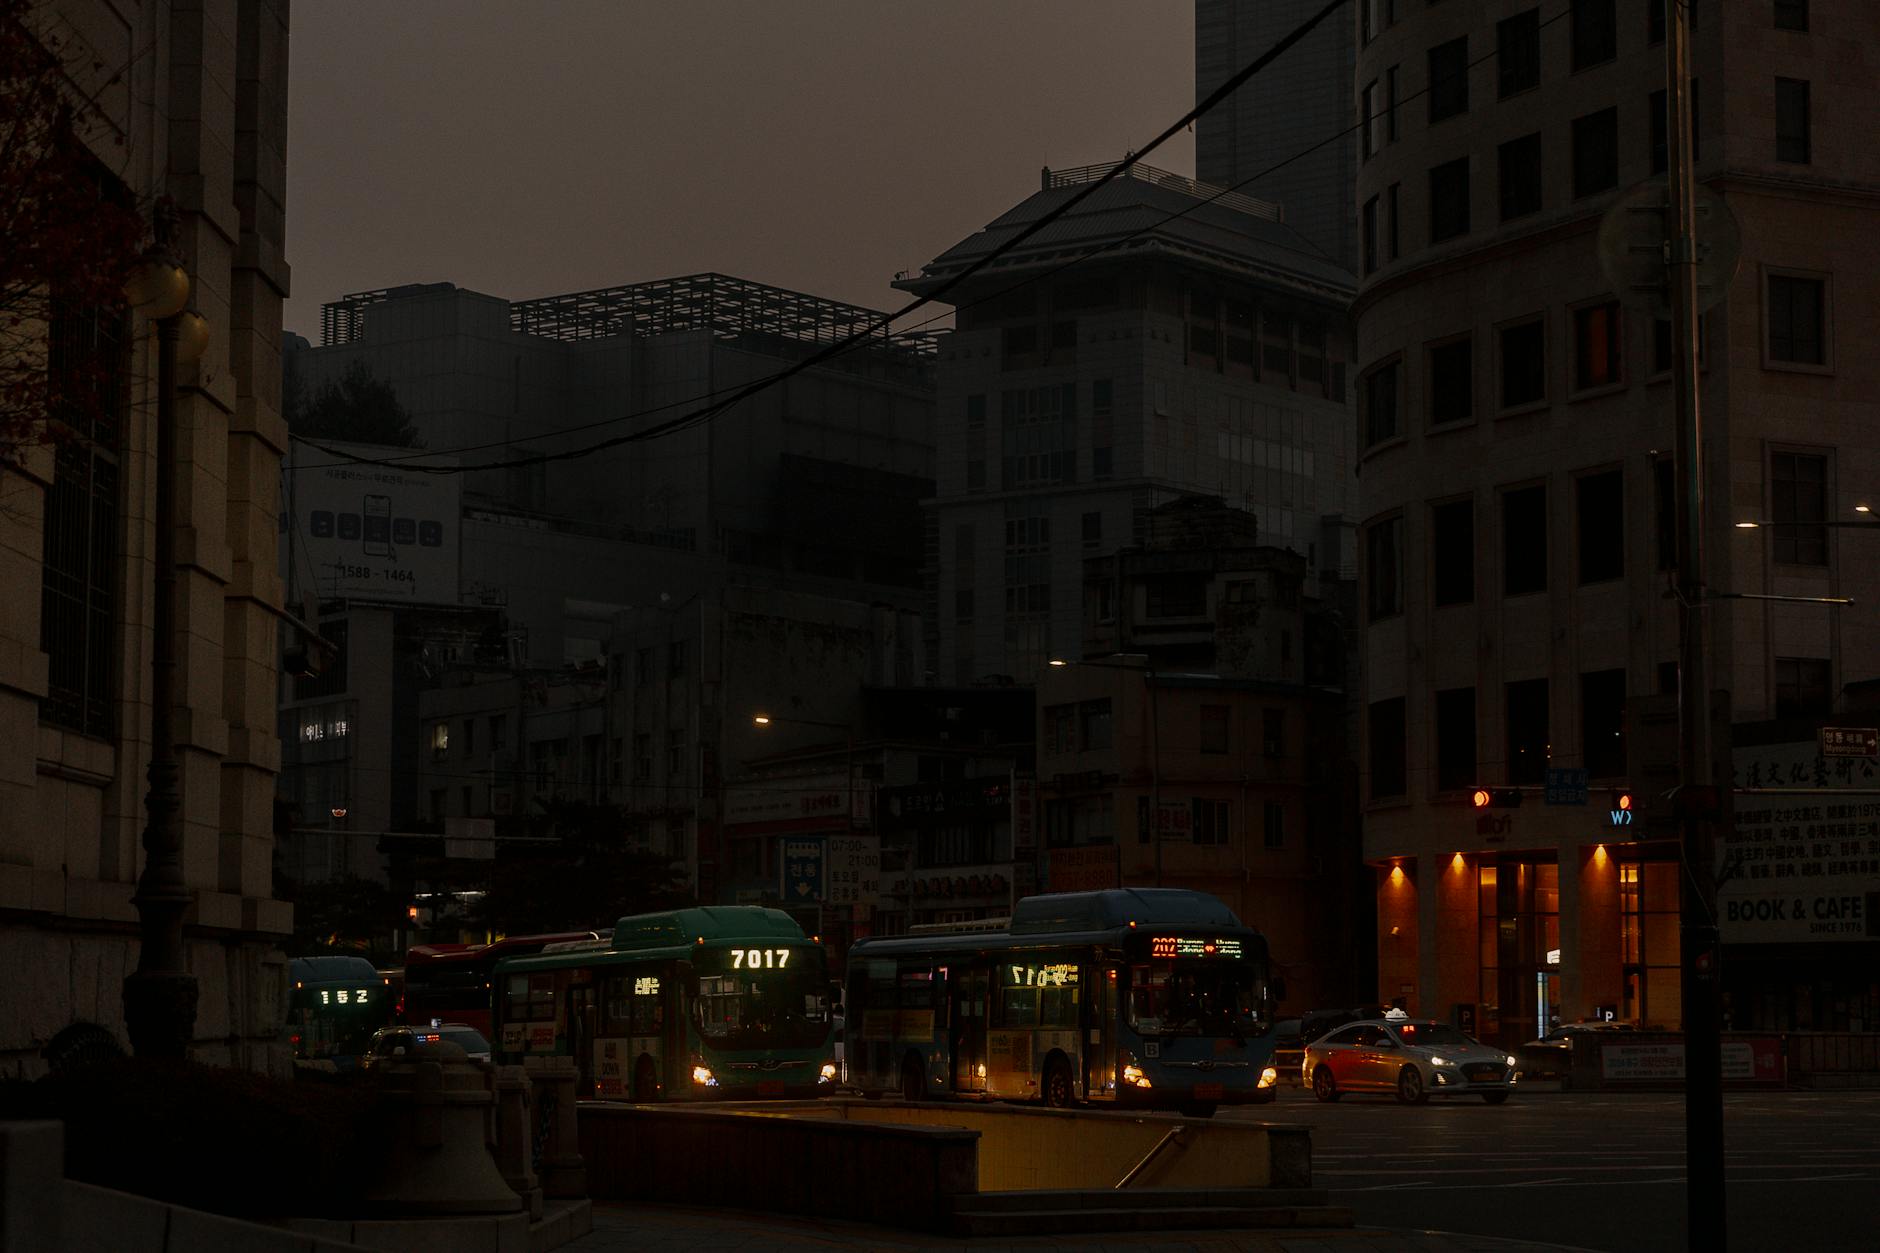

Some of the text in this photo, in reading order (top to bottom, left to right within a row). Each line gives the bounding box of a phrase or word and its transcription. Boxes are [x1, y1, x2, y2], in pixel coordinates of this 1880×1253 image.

[340, 566, 370, 579] 1588
[384, 569, 413, 582] 1464
[848, 855, 878, 866] 21:00
[831, 870, 859, 883] 토요일
[1727, 896, 1861, 921] BOOK & CAFE
[1810, 923, 1837, 934] SINCE
[731, 949, 789, 969] 7017
[1605, 1010, 1613, 1023] P
